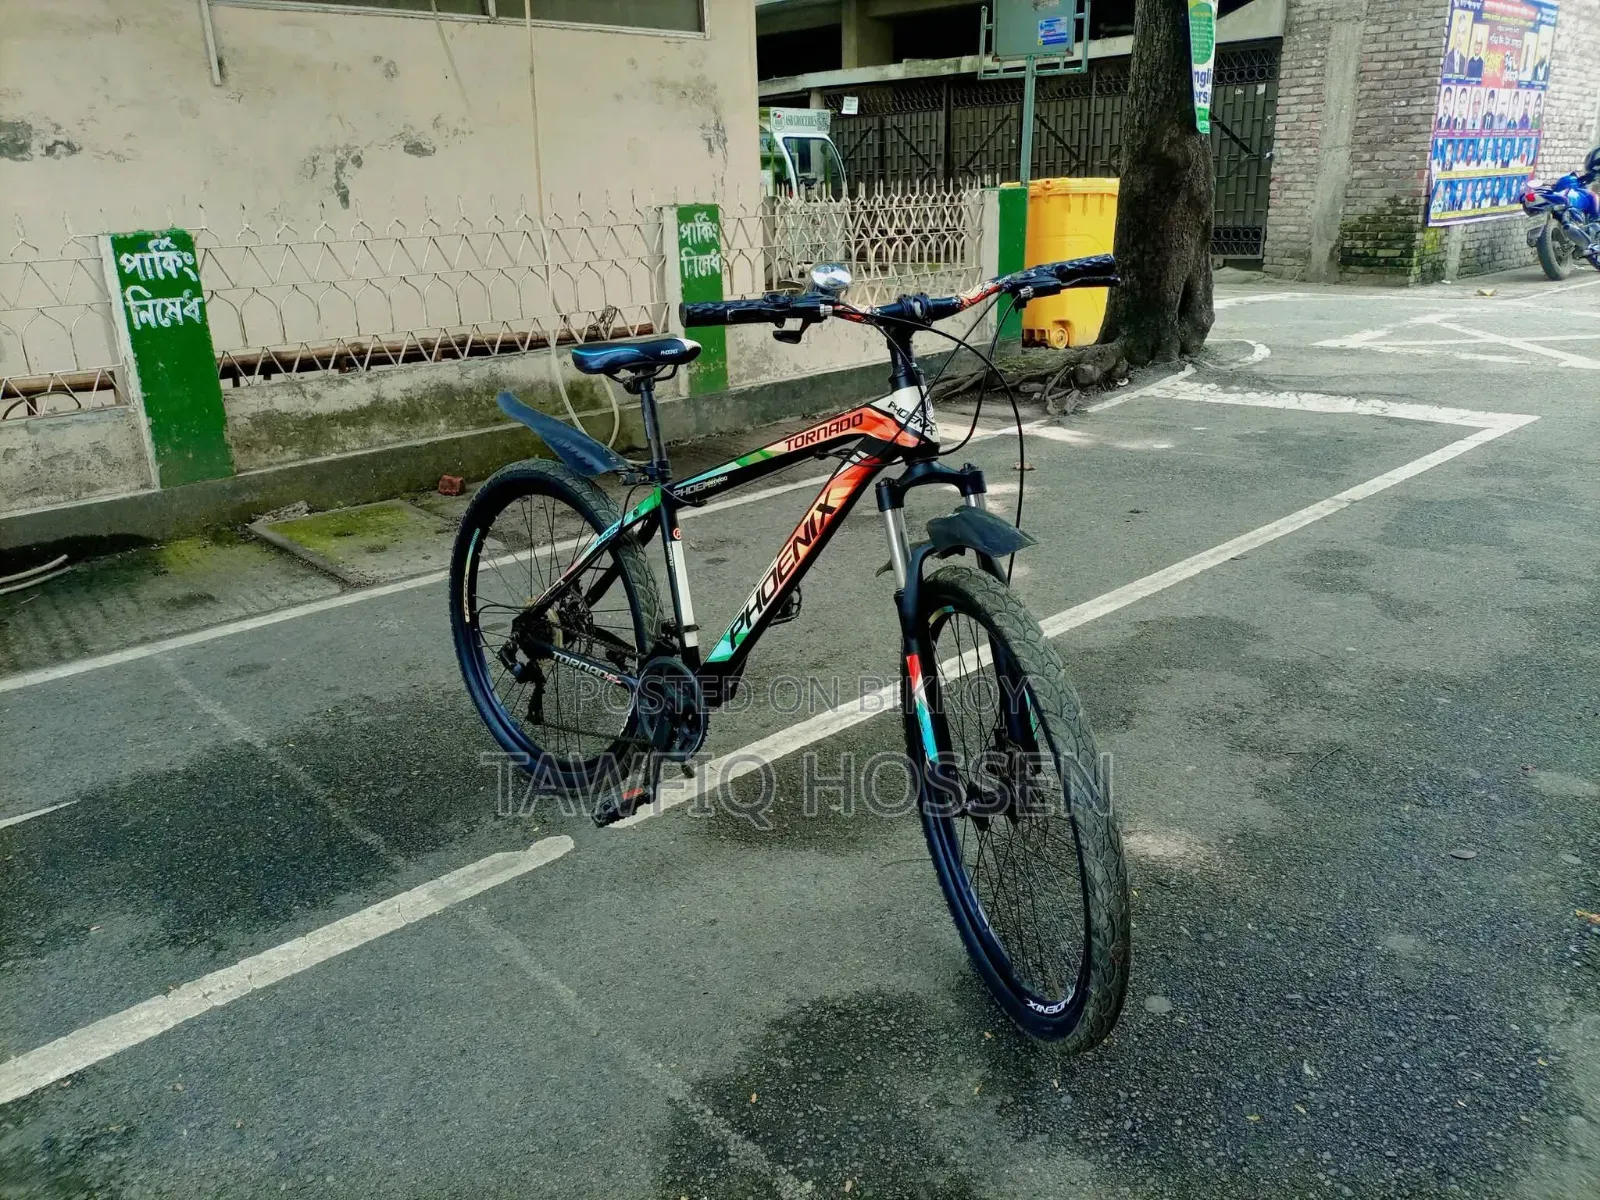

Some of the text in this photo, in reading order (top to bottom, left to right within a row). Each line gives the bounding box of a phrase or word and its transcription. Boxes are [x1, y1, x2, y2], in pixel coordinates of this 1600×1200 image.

[679, 211, 720, 246] পার্কিং
[120, 236, 198, 282] পার্কিং
[125, 285, 204, 330] নিষেধ
[784, 412, 864, 451] TORNADO
[729, 486, 837, 651] PHOENIX
